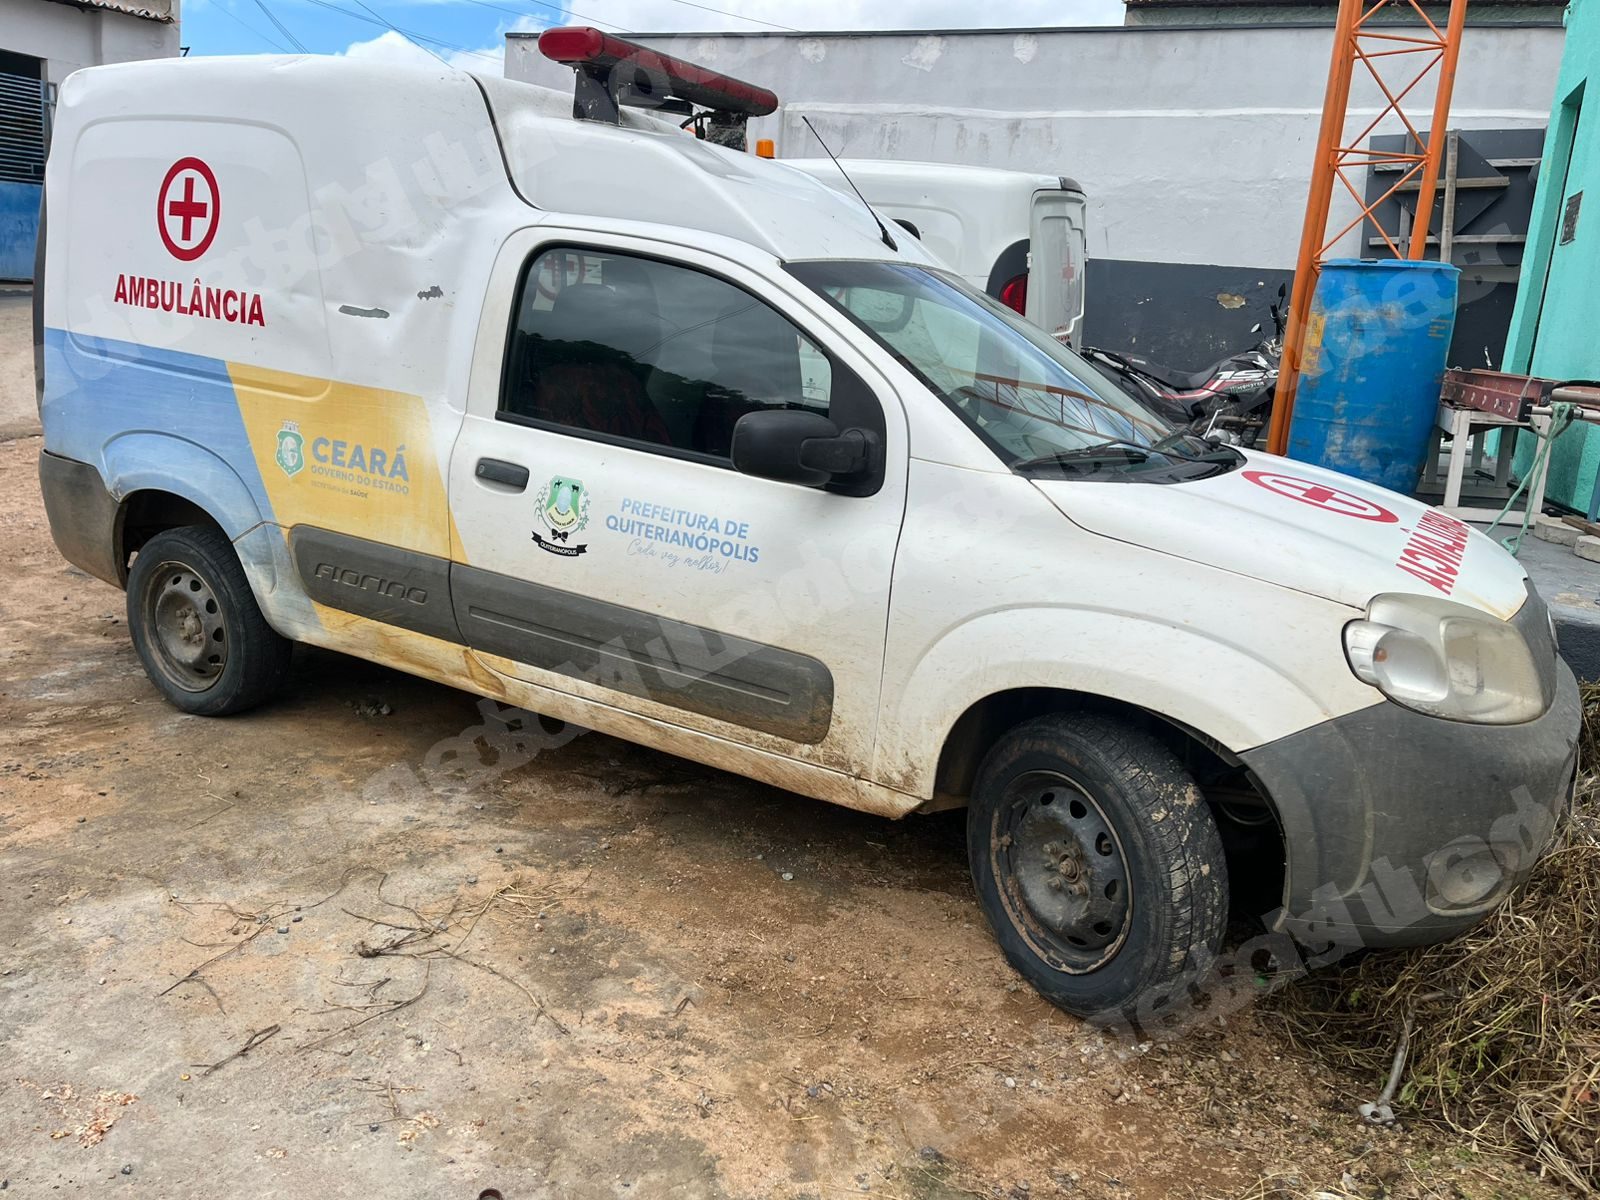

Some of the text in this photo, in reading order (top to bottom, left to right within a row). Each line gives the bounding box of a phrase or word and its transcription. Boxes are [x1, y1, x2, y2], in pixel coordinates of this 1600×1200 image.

[113, 273, 266, 327] AMBULÂNCIA
[311, 436, 410, 483] CEARÁ
[311, 464, 409, 495] GOVERNO DO ESTADO
[605, 514, 760, 563] QUITERIANÓPOLIS
[621, 497, 750, 540] PREFEITURA DE
[625, 537, 731, 575] Cada vez melhor!
